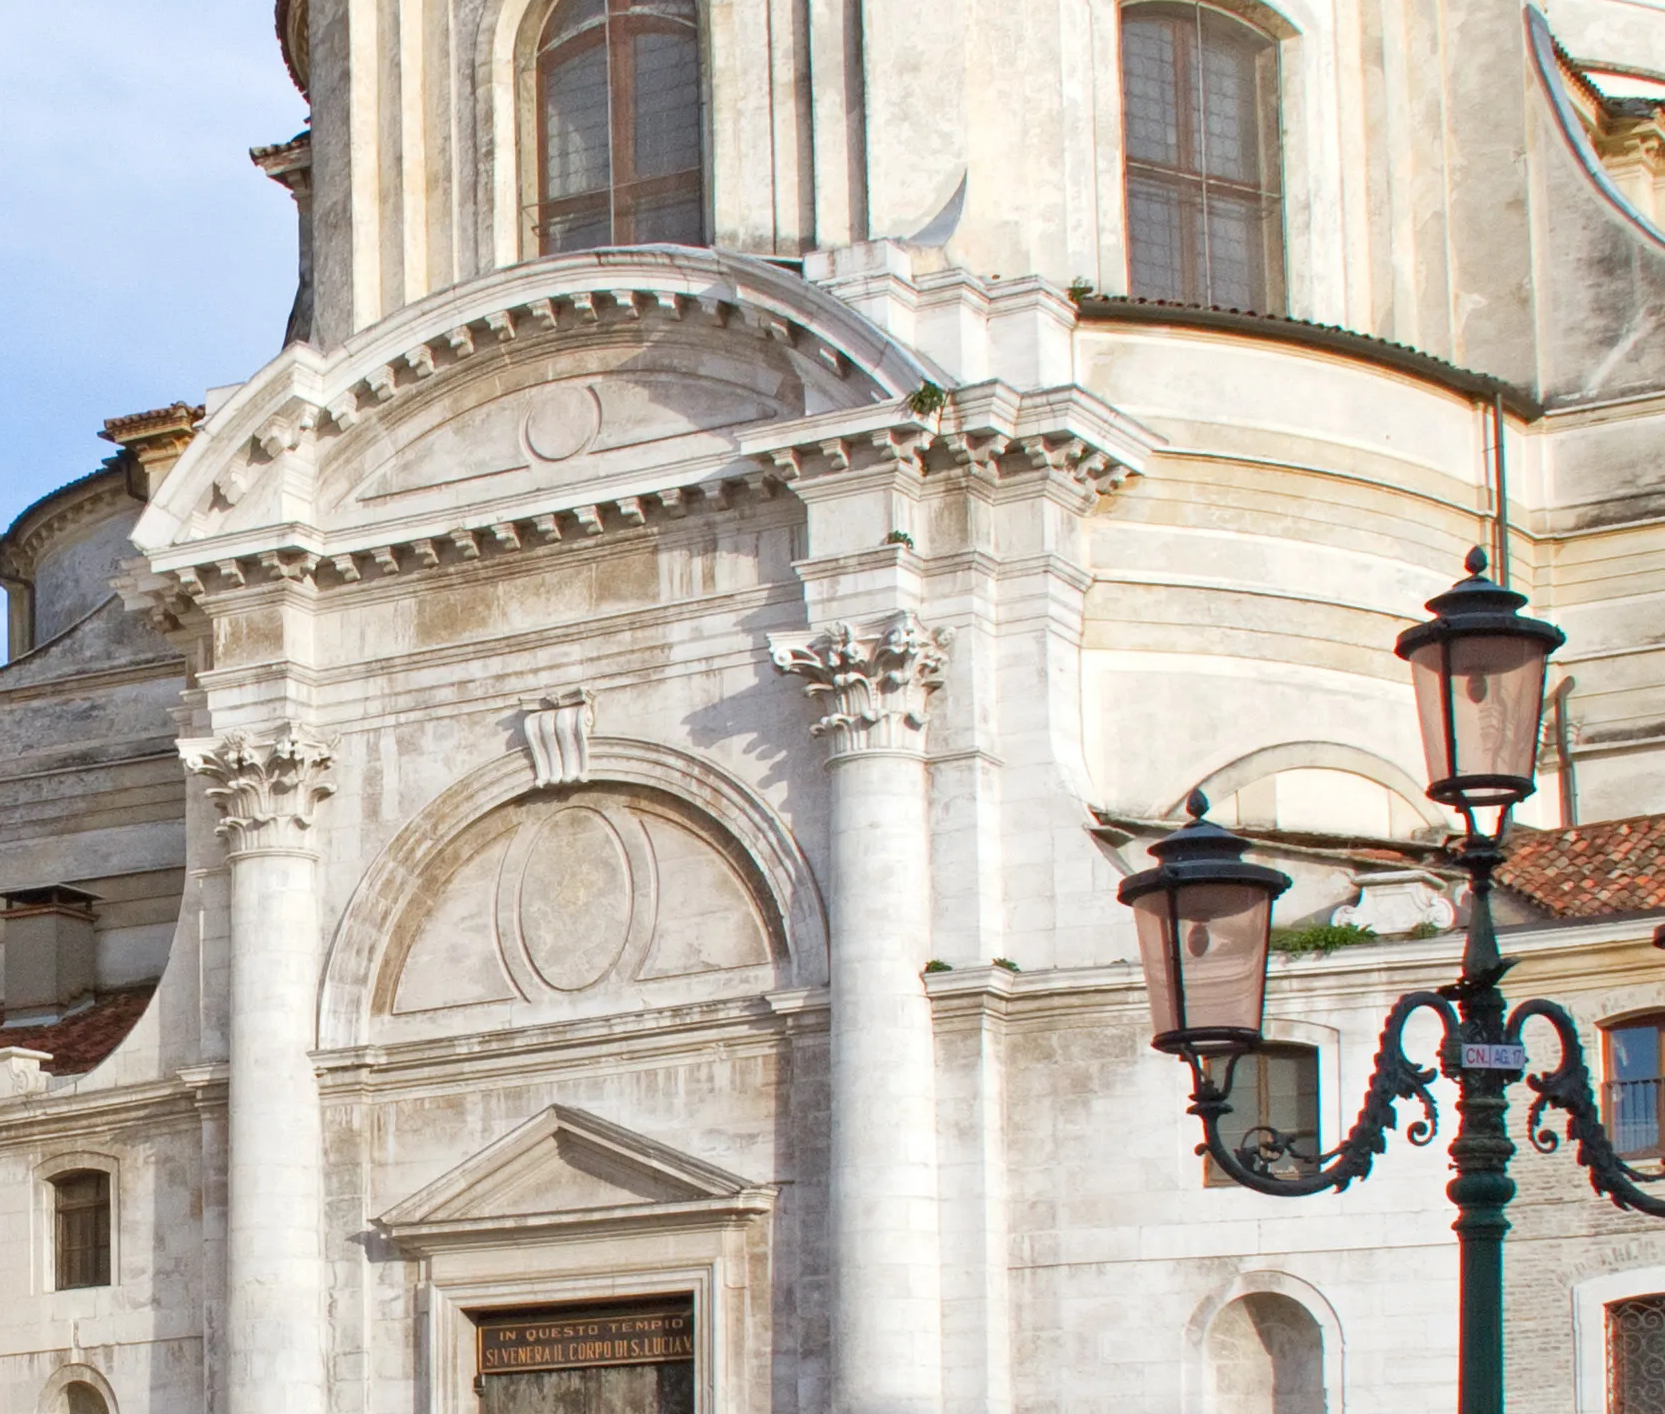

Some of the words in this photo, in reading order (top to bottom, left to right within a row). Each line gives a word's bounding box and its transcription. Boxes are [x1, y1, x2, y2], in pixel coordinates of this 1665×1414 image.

[499, 1330, 516, 1341] IN
[526, 1325, 598, 1341] QUESTO
[608, 1319, 683, 1333] TEMPIO
[486, 1349, 498, 1366] SI
[501, 1345, 550, 1364] VENERA
[554, 1345, 564, 1362] IL
[569, 1340, 611, 1360] CORPO
[616, 1340, 627, 1358] DI
